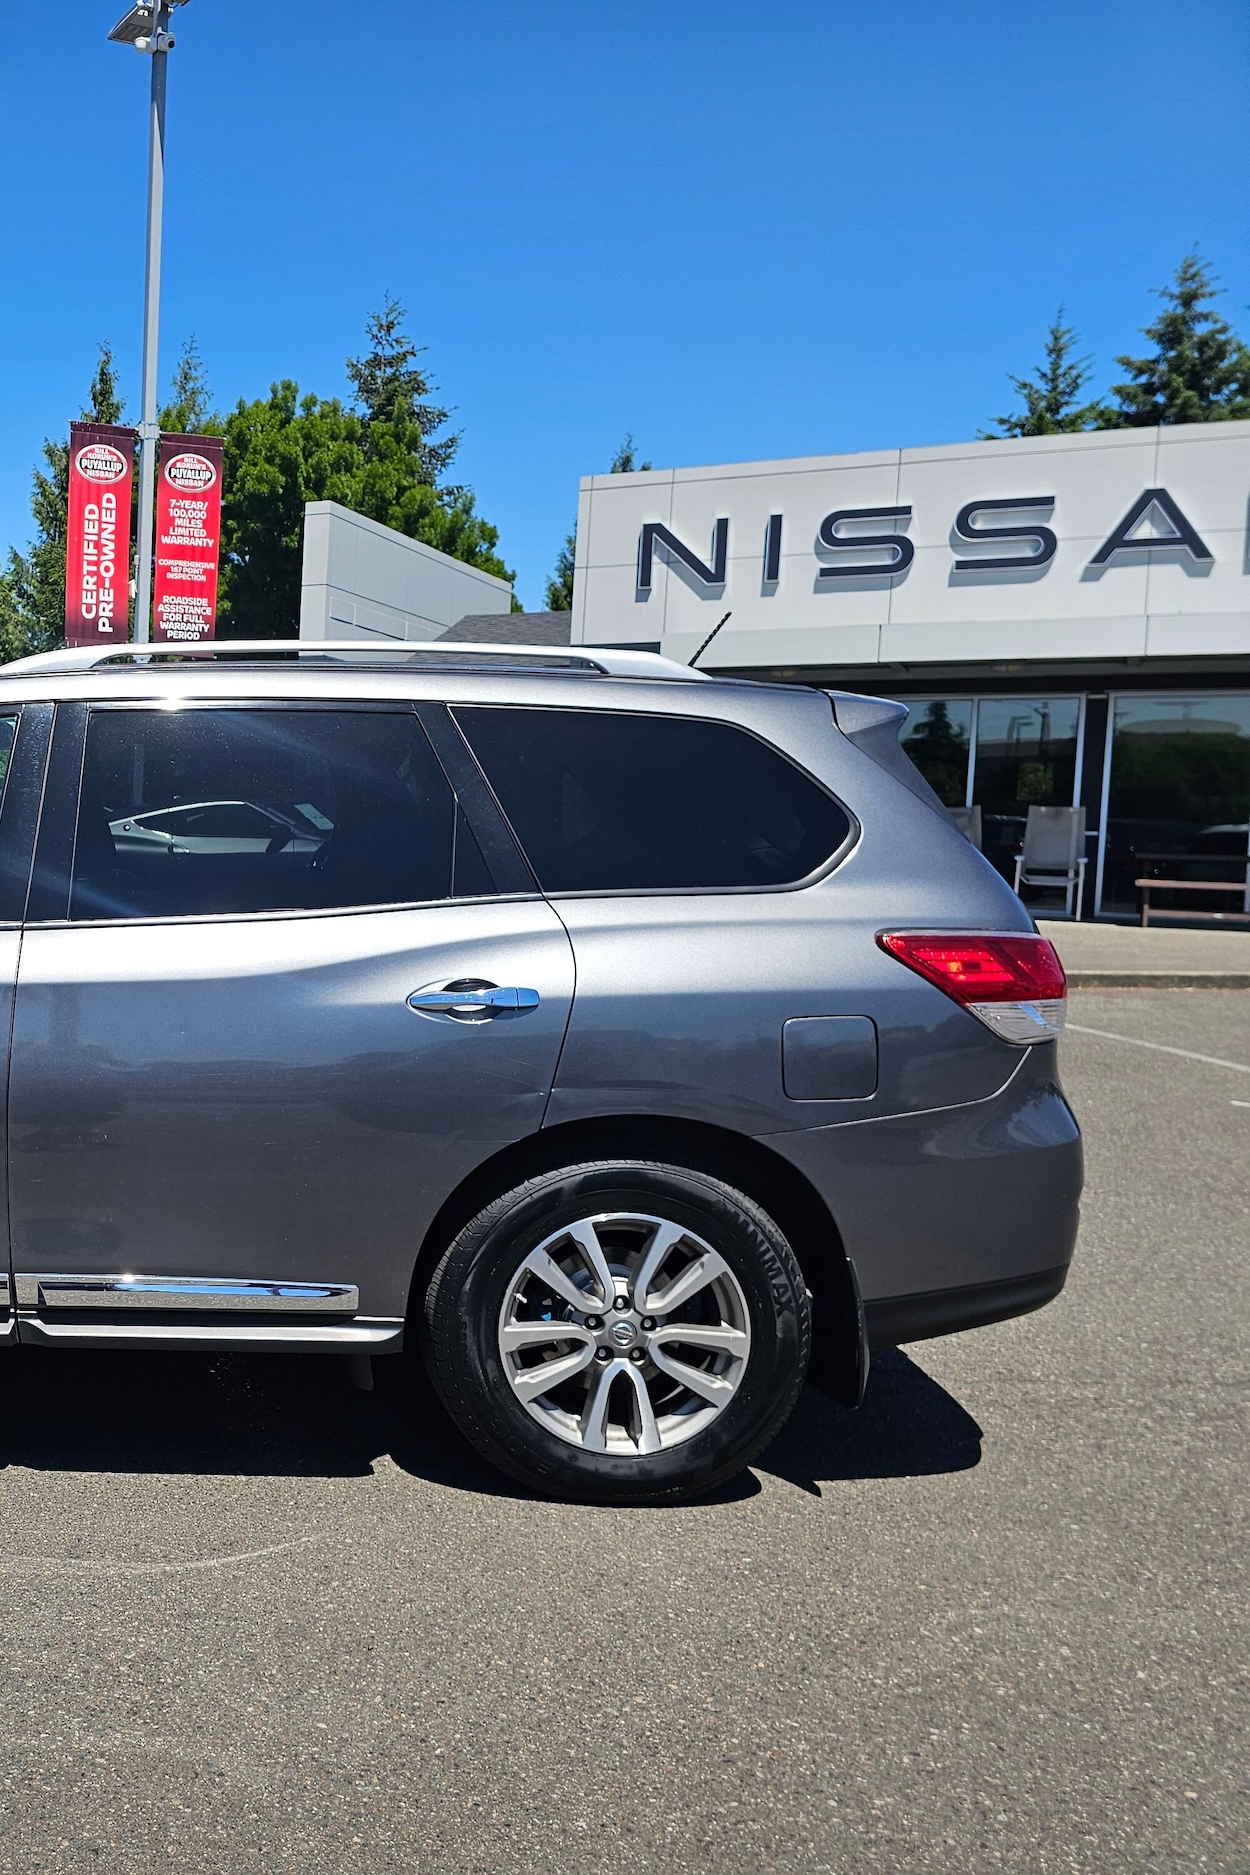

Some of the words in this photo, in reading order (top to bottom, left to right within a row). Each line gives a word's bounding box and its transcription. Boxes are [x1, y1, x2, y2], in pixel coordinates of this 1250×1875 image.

[94, 447, 110, 455] BILL
[81, 458, 123, 473] PUYALLUP
[183, 456, 198, 464] BILL
[87, 469, 115, 479] NISSAN
[170, 467, 211, 481] PUYALLUP
[176, 478, 204, 488] NISSAN
[170, 499, 208, 511] 7-YEAR/
[168, 508, 207, 520] 100,000
[174, 517, 203, 528] MILES
[169, 526, 207, 538] LIMITED
[160, 535, 214, 548] WARRANTY
[638, 488, 1250, 590] NISSA
[81, 503, 99, 619] CERTIFIED
[98, 492, 117, 633] PRE-OWNED
[158, 558, 215, 569] COMPREHENSIVE
[183, 567, 204, 575] POINT
[166, 572, 206, 582] INSPECTION
[162, 595, 208, 606] ROADSIDE
[157, 604, 212, 616] ASSISTANCE
[162, 613, 182, 622] FOR
[183, 614, 205, 624] FULL
[159, 621, 210, 633] WARRANTY
[167, 630, 200, 640] PERIOD
